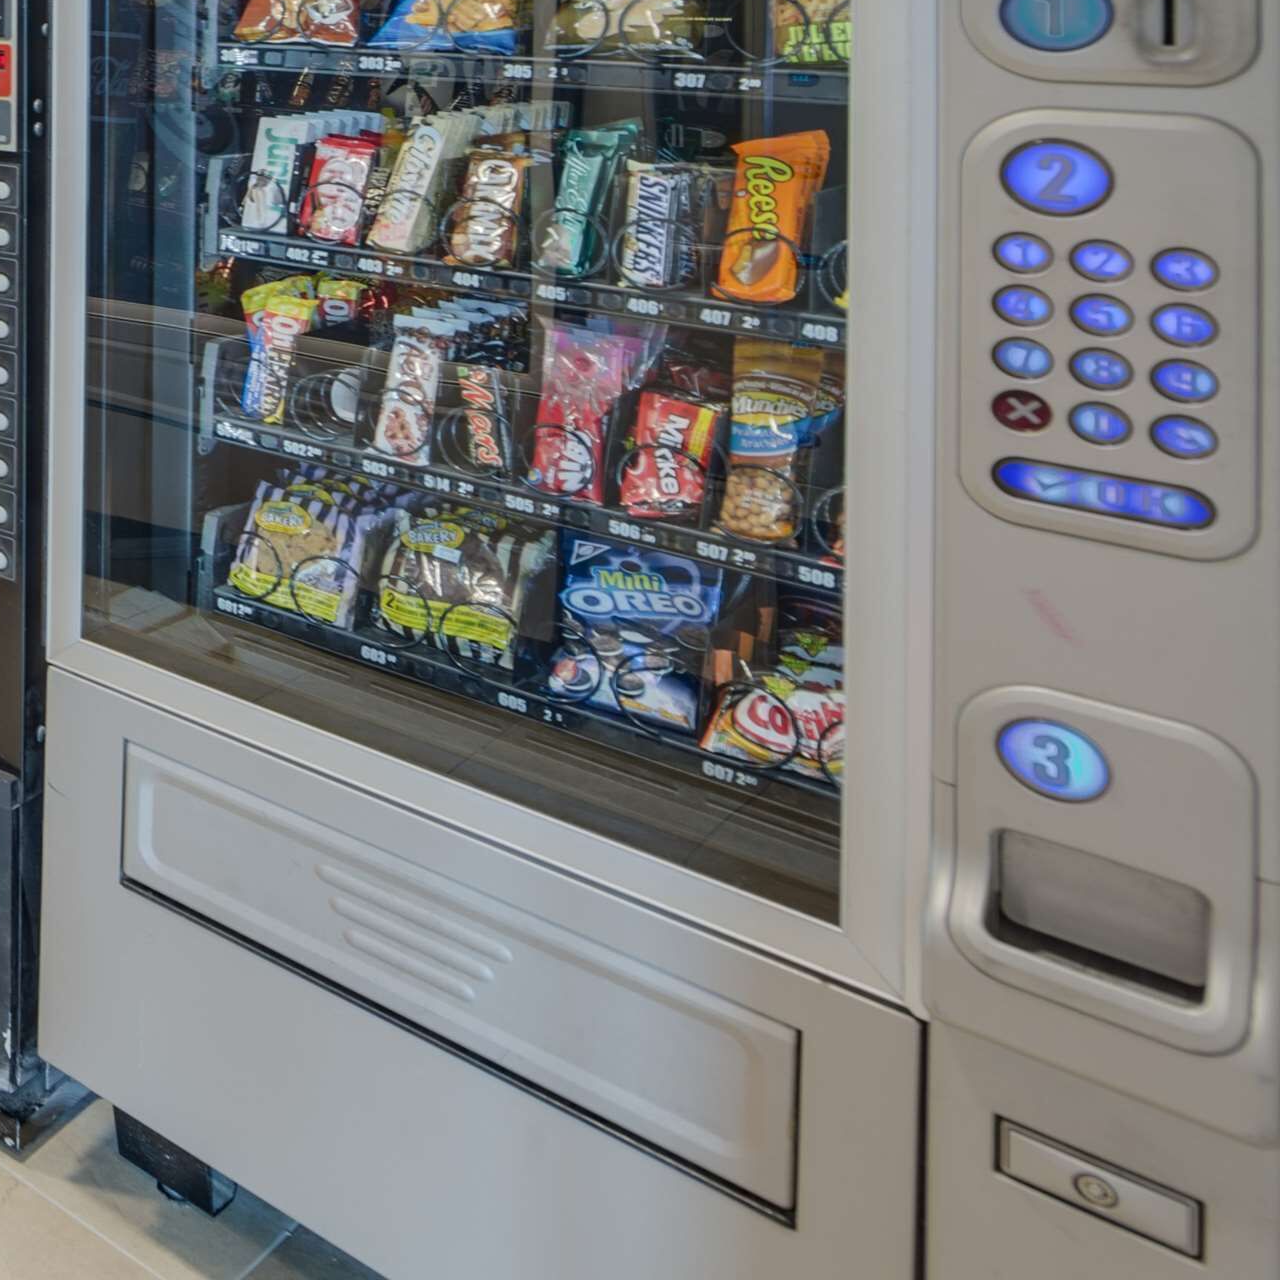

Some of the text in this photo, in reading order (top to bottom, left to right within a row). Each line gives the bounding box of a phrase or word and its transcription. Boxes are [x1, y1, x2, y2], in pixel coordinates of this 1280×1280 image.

[674, 72, 706, 89] 307
[1038, 154, 1080, 205] 2
[537, 284, 567, 302] 405
[627, 297, 660, 315] 406
[700, 307, 732, 326] 407
[802, 323, 839, 343] 408
[457, 376, 503, 468] Mars
[362, 458, 388, 478] 503
[505, 495, 534, 513] 505
[408, 529, 458, 544] BAKERY
[608, 520, 641, 541] 506
[696, 541, 728, 561] 507
[597, 568, 663, 592] Mini
[798, 565, 836, 588] 508
[567, 586, 705, 617] OREO
[702, 760, 734, 783] 607
[1032, 733, 1072, 790] 3
